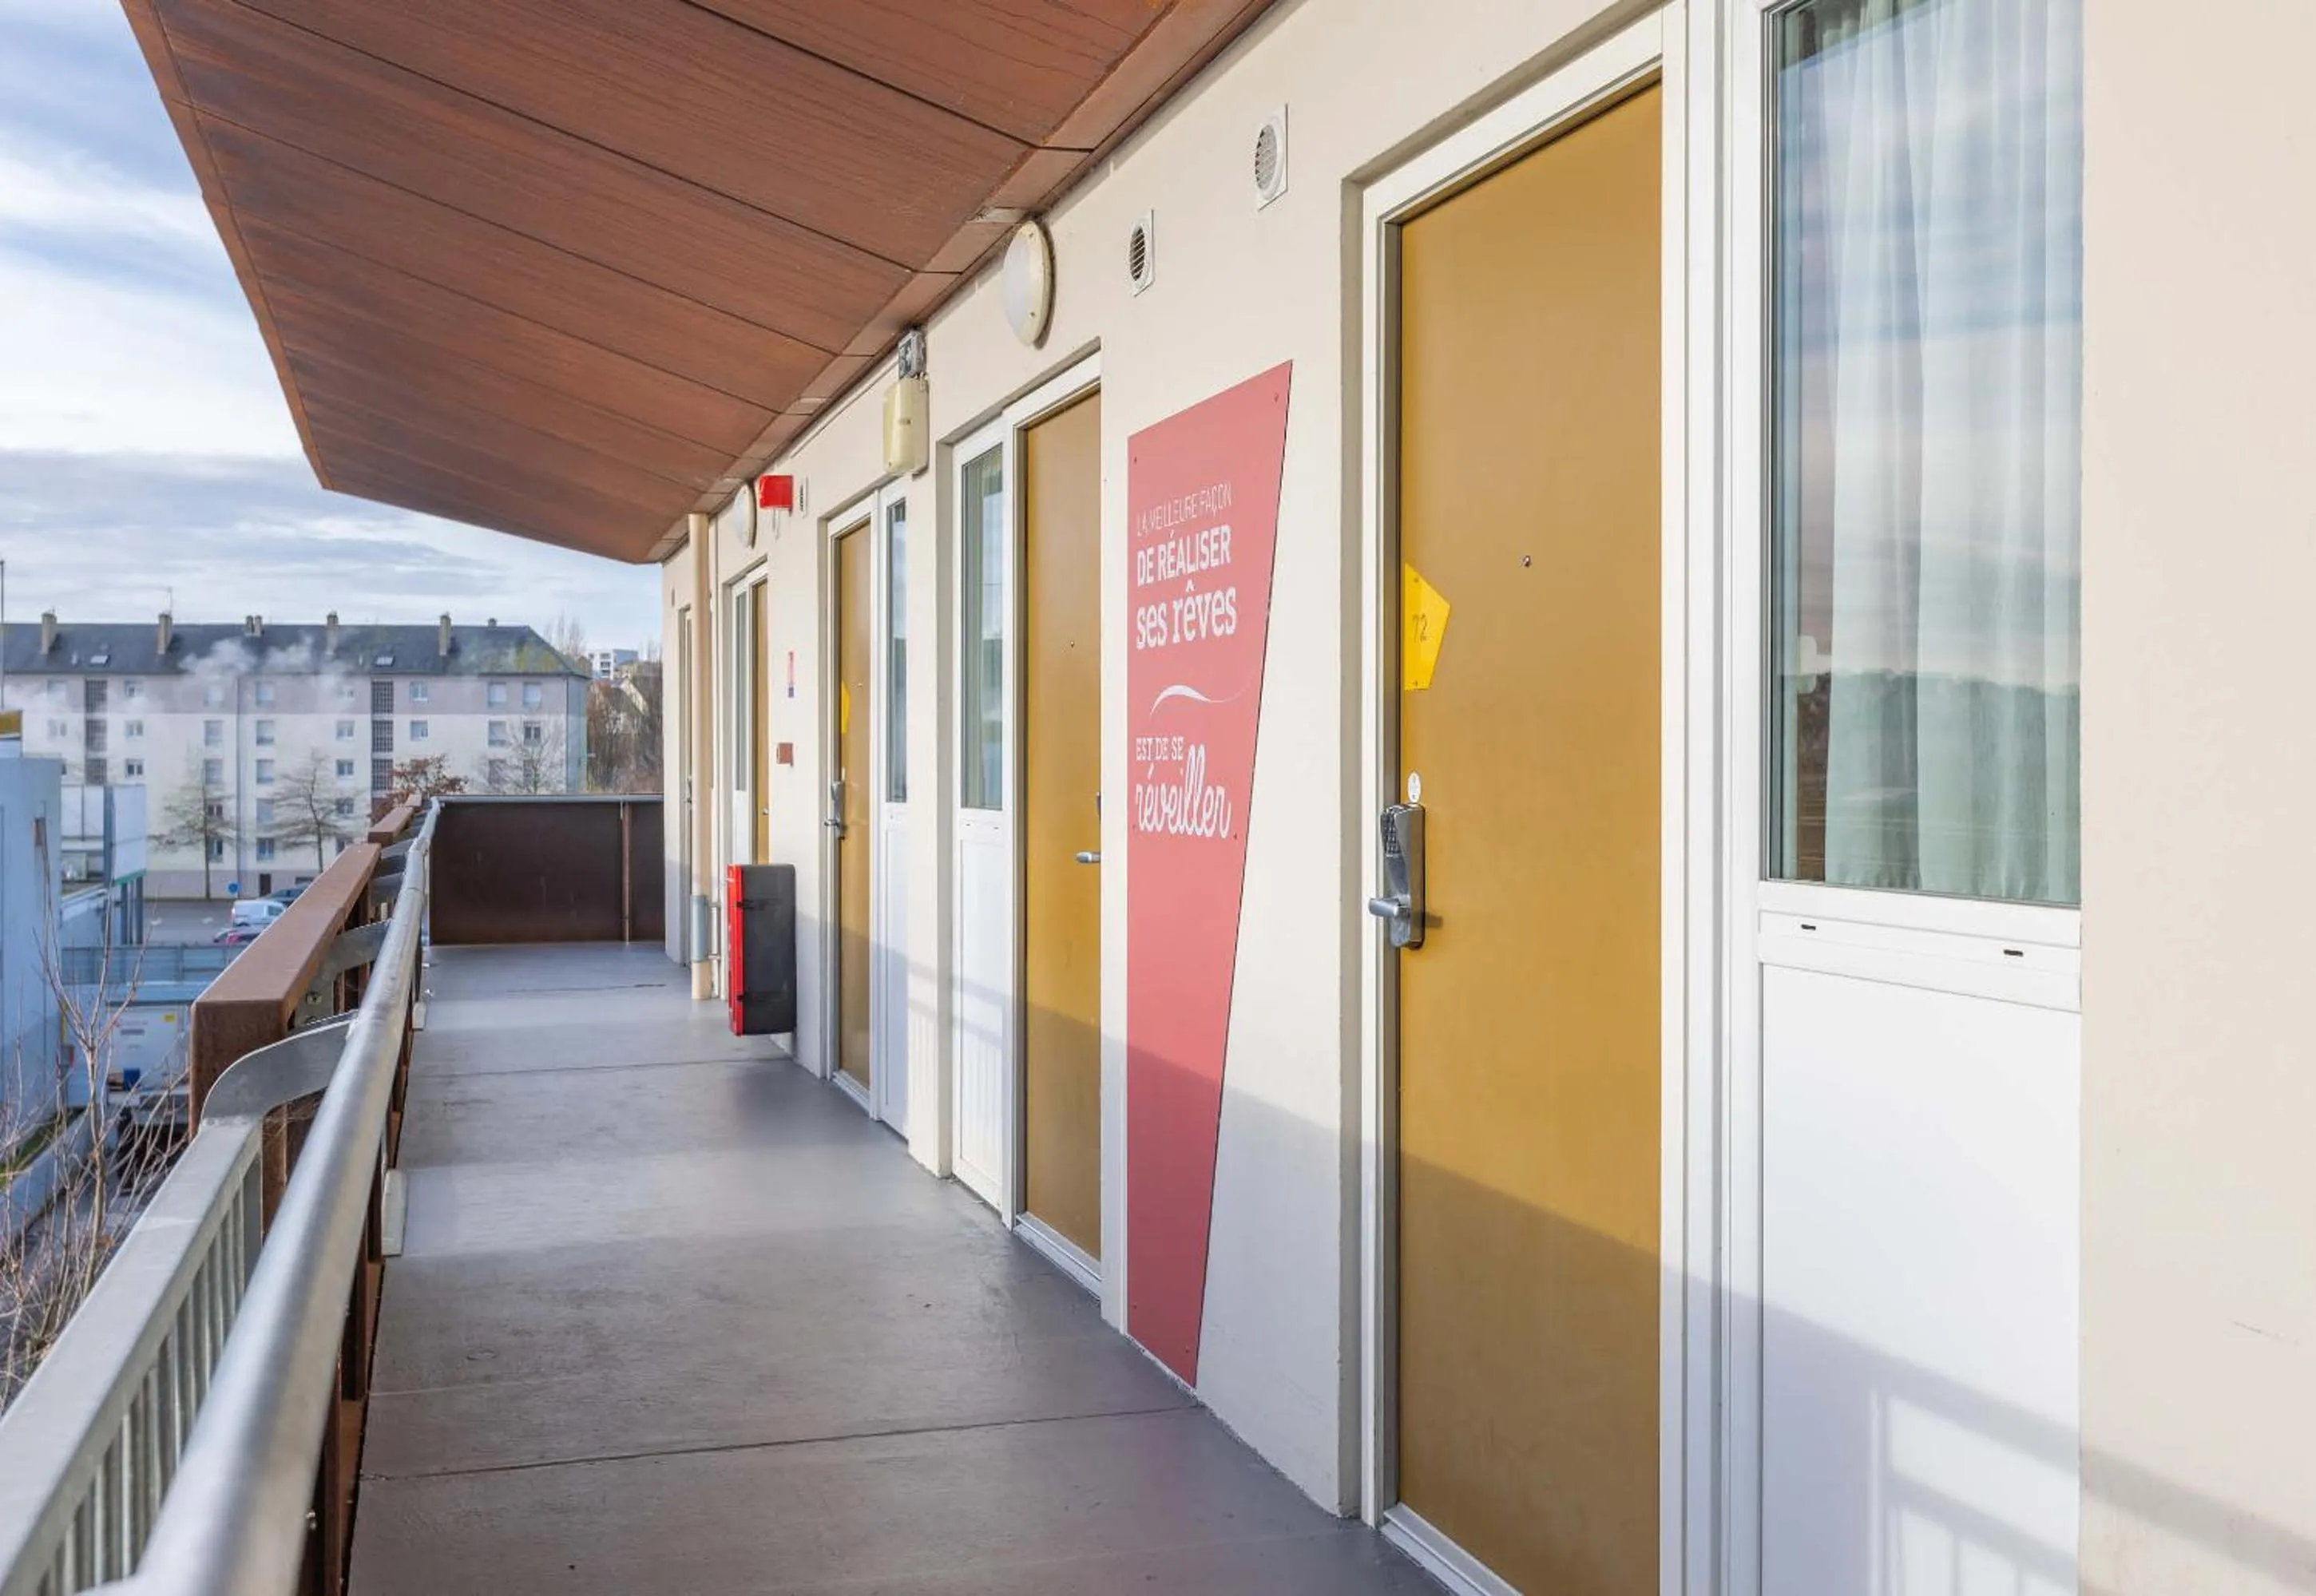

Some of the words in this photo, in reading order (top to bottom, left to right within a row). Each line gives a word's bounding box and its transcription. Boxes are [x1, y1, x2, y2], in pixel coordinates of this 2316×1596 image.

[1137, 547, 1154, 586] DE
[1158, 525, 1231, 581] RÉALISER
[1136, 602, 1168, 649] ses
[1172, 579, 1236, 644] rêves
[1136, 737, 1152, 760] EST
[1155, 737, 1168, 760] DE
[1171, 736, 1184, 761] SE
[1136, 744, 1231, 839] réveiller
